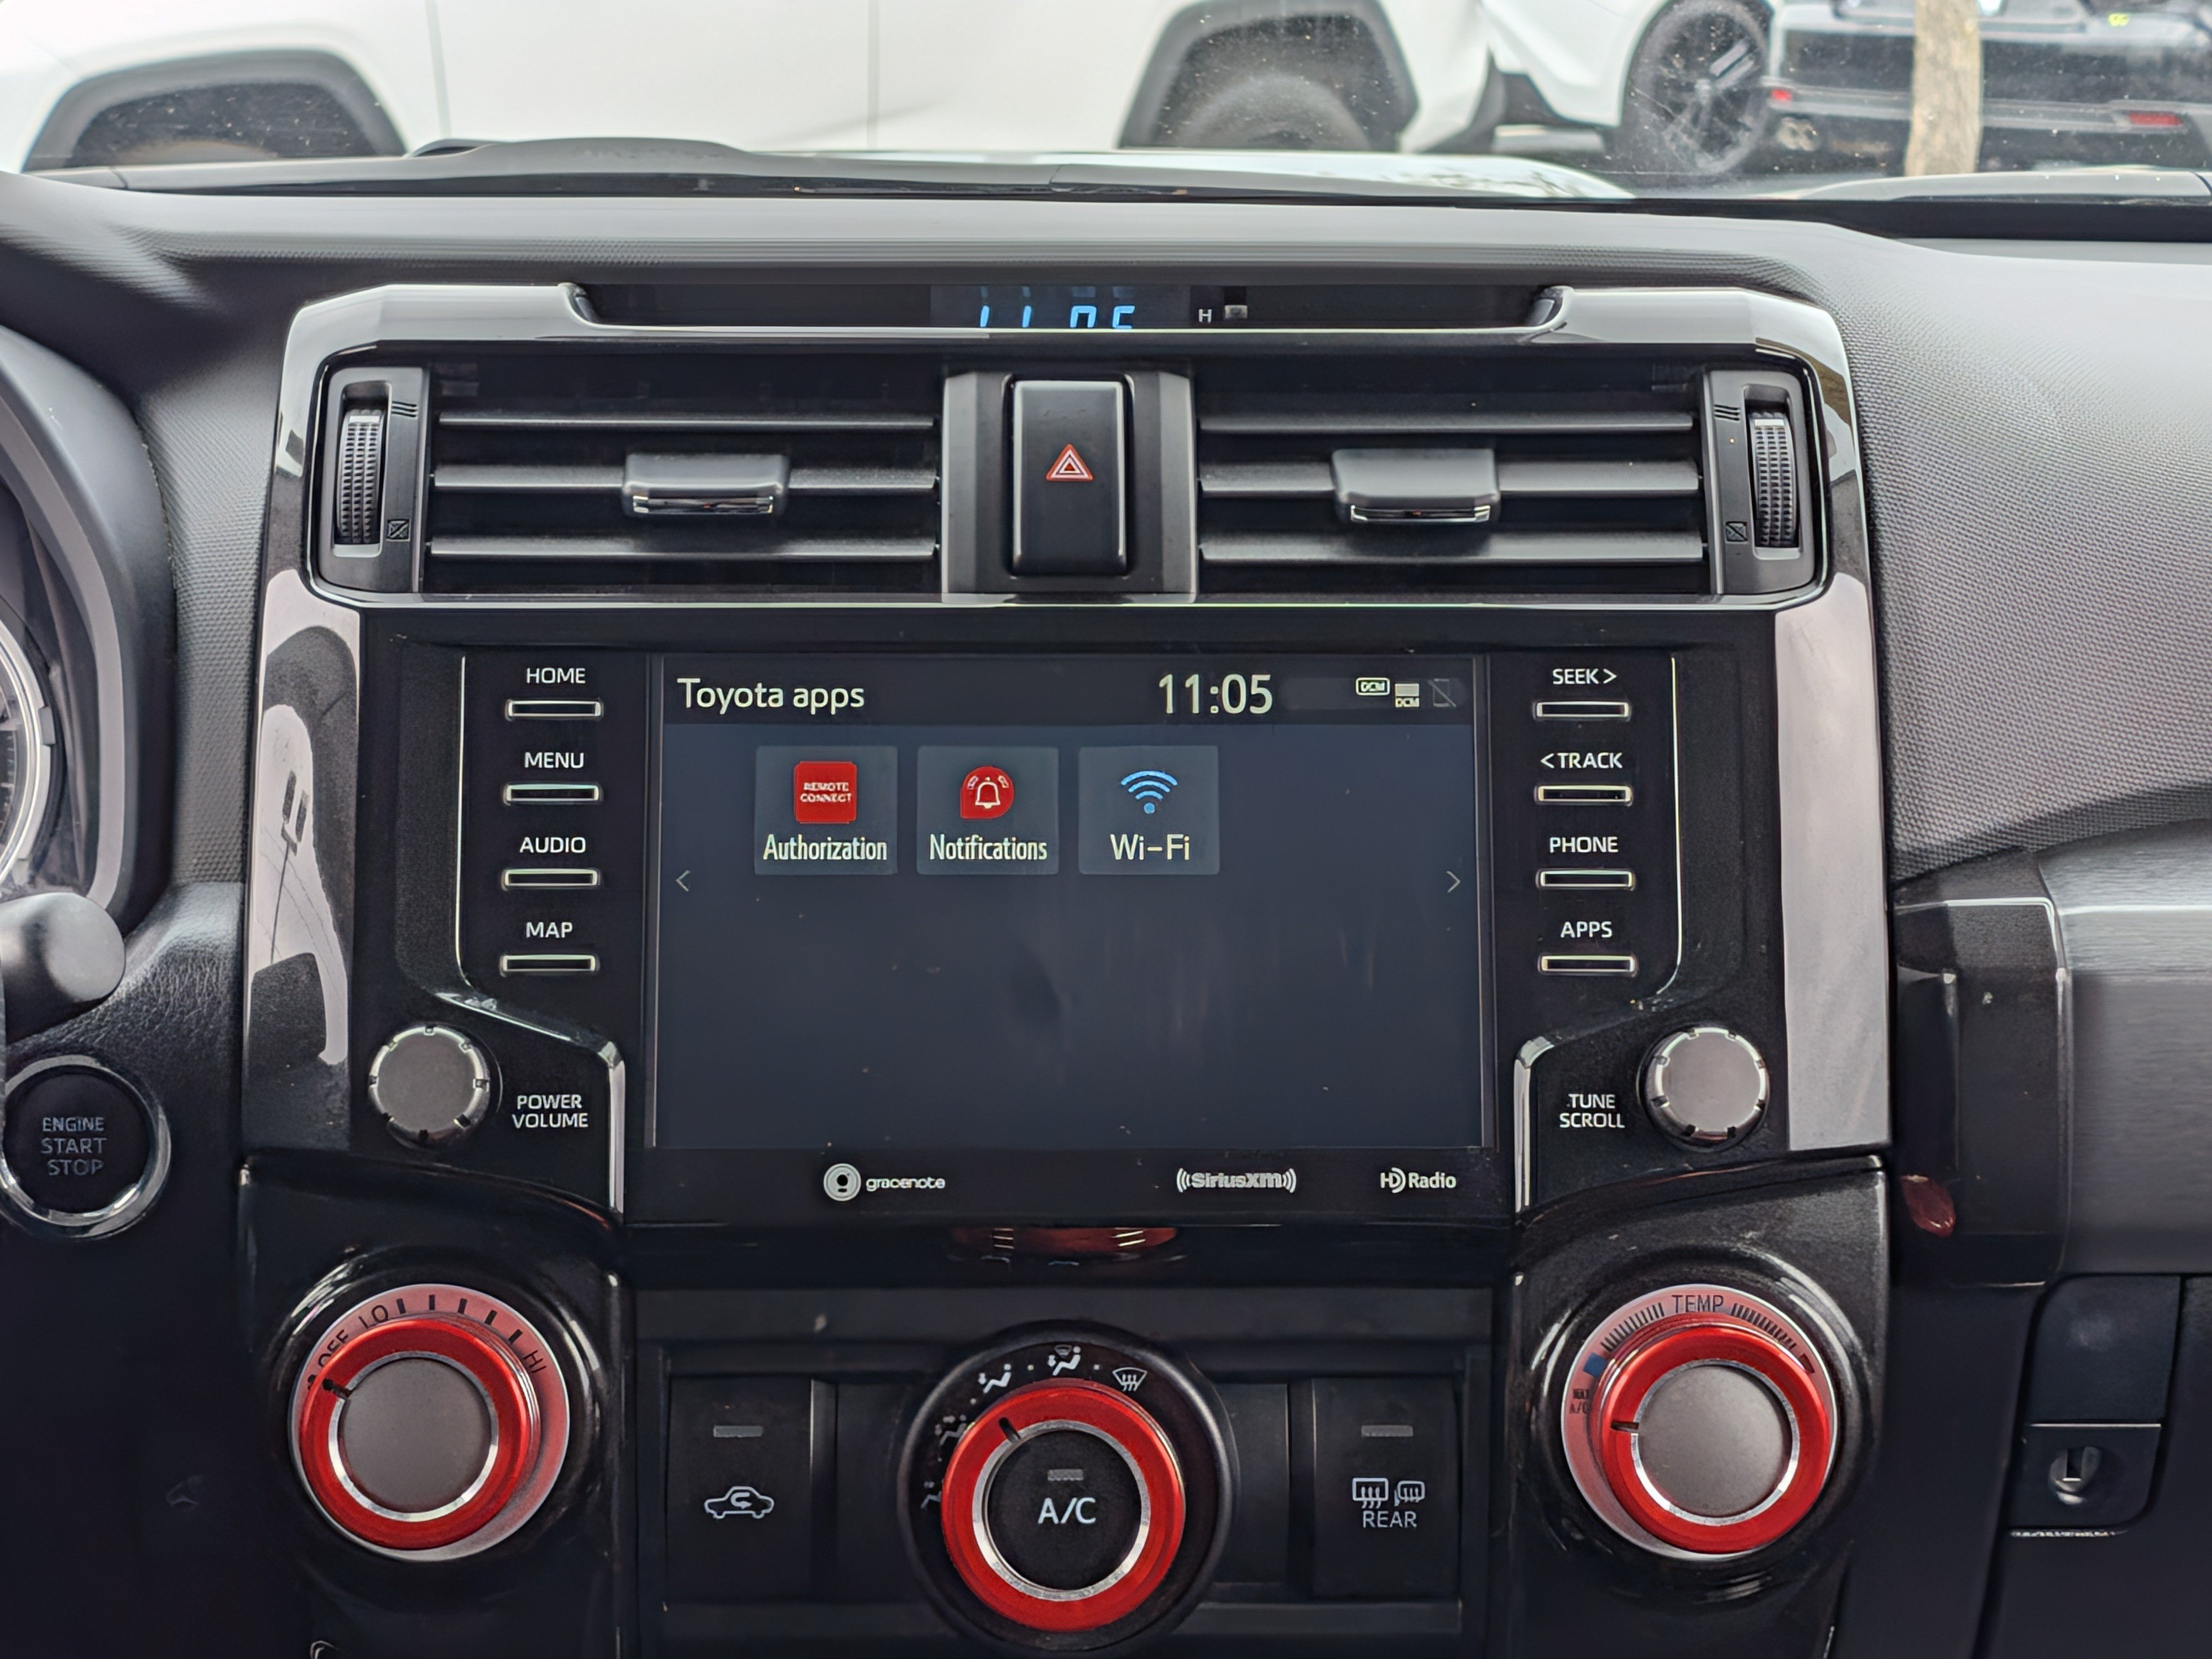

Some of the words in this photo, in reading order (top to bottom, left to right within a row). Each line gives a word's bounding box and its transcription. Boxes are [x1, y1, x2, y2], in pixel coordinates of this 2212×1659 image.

[526, 666, 586, 685] HOME
[676, 677, 784, 714] Toyota
[792, 687, 865, 715] apps
[1158, 673, 1273, 714] 11:05
[524, 751, 585, 769] MENU
[803, 782, 849, 792] REMOTE
[800, 792, 852, 803] CONNECT
[519, 836, 587, 854] AUDIO
[763, 833, 888, 861] Authorization
[930, 833, 1048, 860] Notifications
[1109, 833, 1191, 861] Wi-Fi
[1549, 836, 1619, 854] PHONE
[526, 921, 573, 939] MAP
[1559, 920, 1613, 938] APPS
[517, 1093, 583, 1110] POWER
[1568, 1093, 1616, 1109] TUNE
[41, 1116, 105, 1133] ENGINE
[512, 1112, 589, 1129] VOLUME
[1559, 1112, 1626, 1129] SCROLL
[41, 1136, 107, 1155] START
[47, 1158, 104, 1176] STOP
[865, 1176, 946, 1192] gracenote
[1408, 1171, 1457, 1189] Radio
[1671, 1294, 1724, 1313] TEMP
[523, 1349, 547, 1373] HI
[1037, 1496, 1097, 1525] A/C
[1362, 1510, 1418, 1528] REAR
